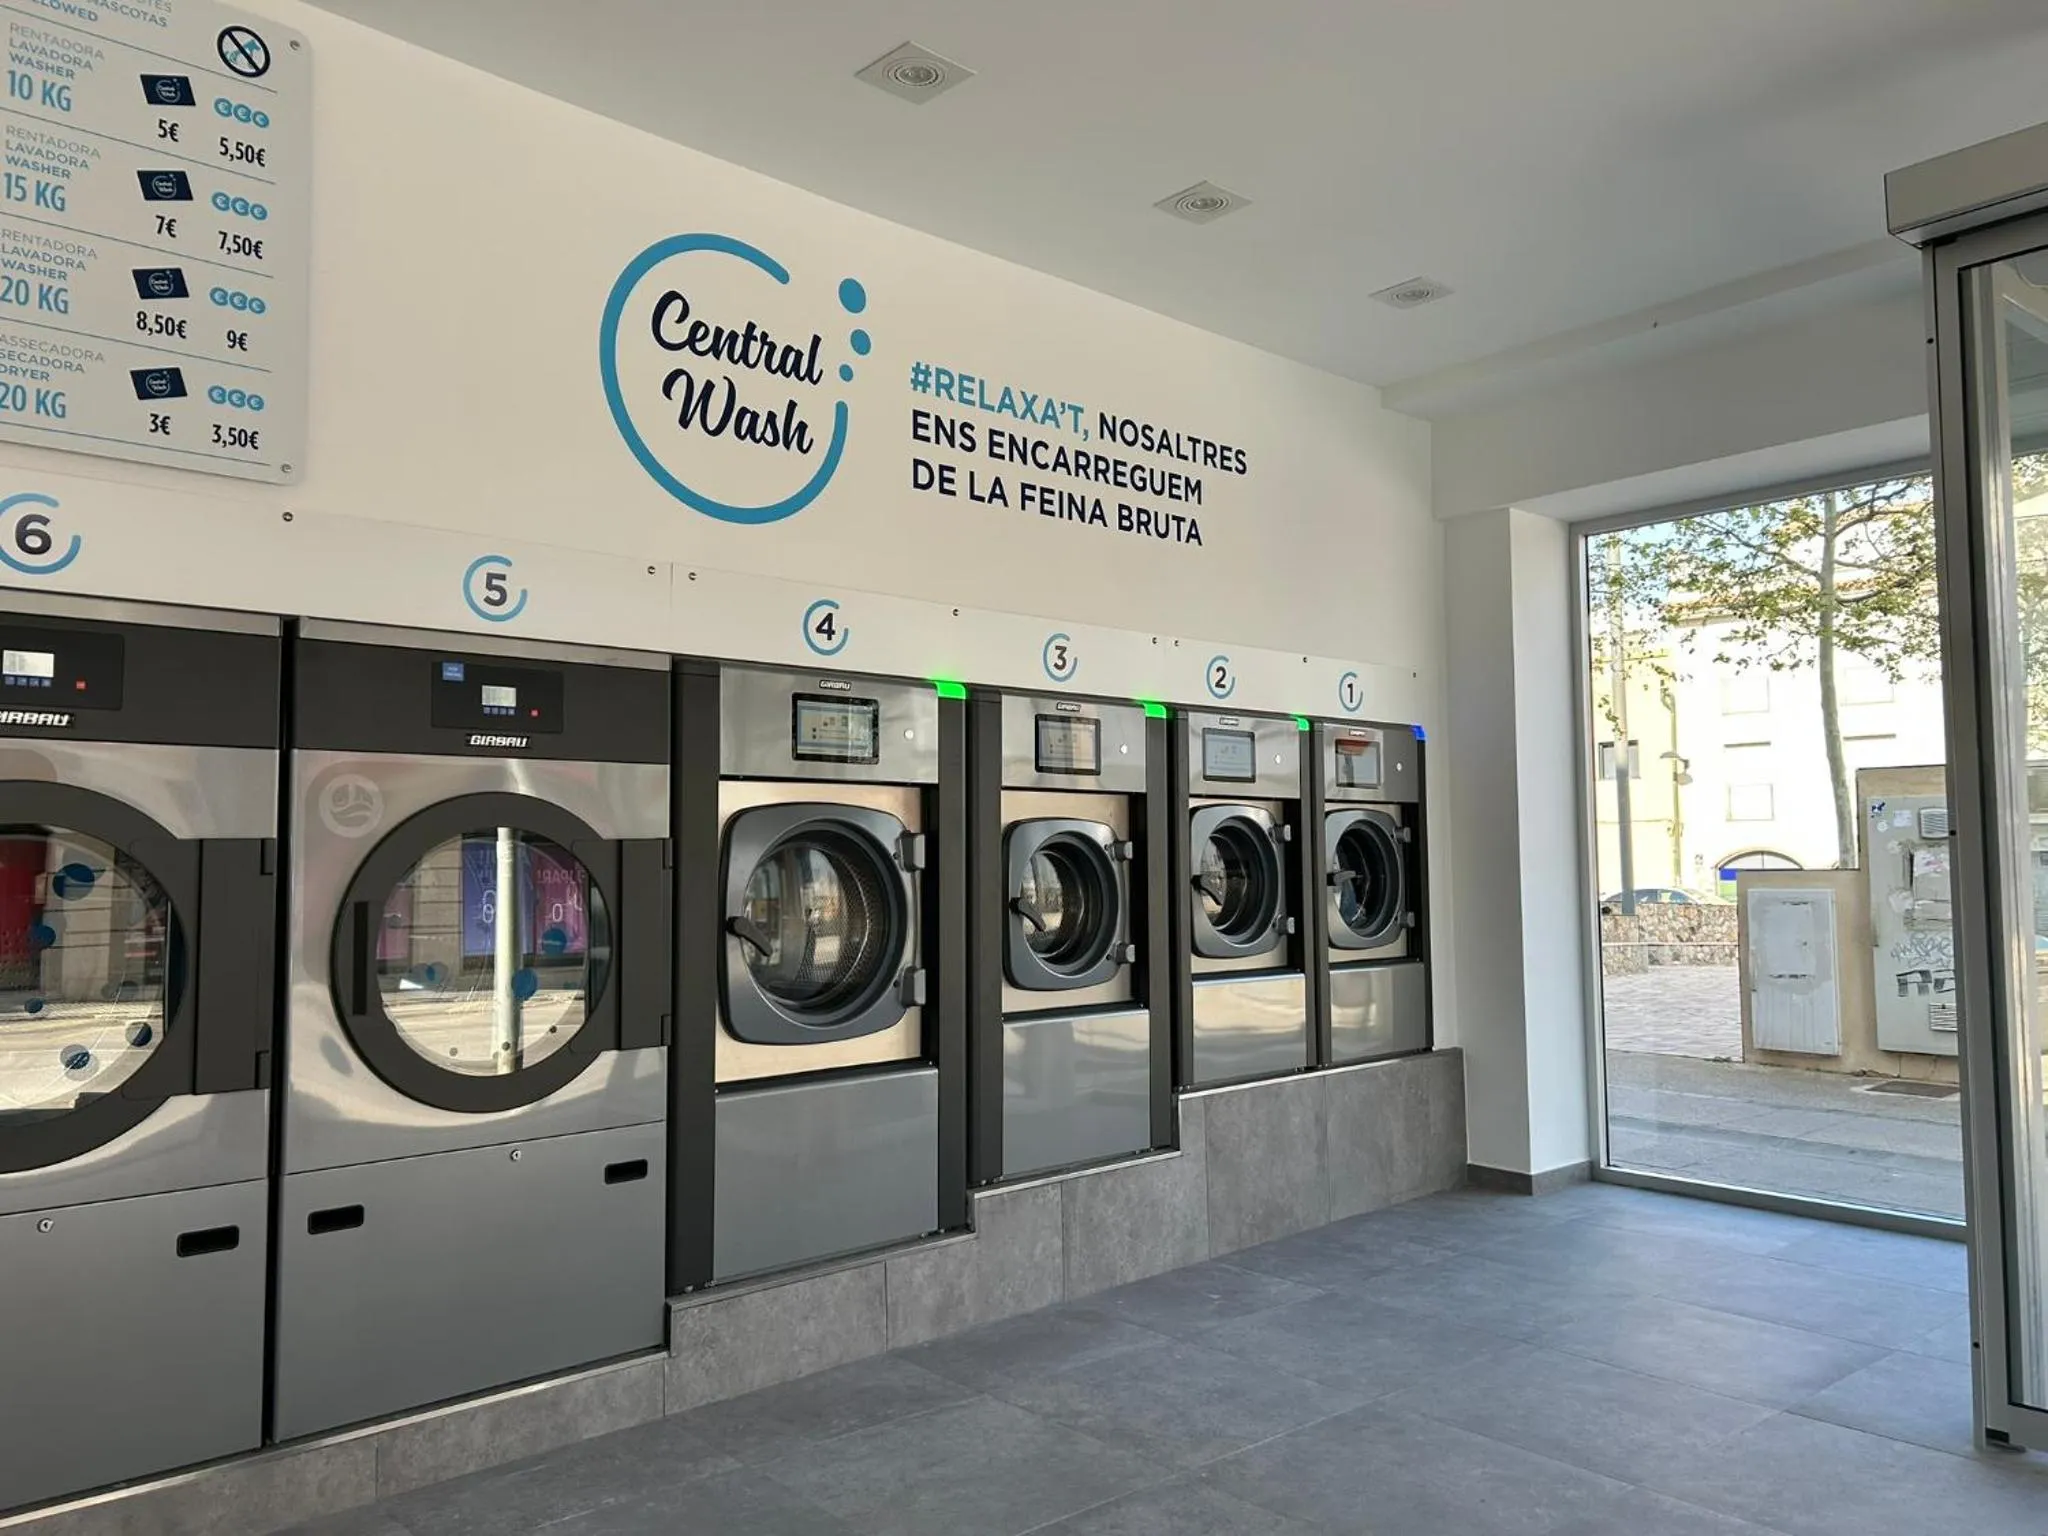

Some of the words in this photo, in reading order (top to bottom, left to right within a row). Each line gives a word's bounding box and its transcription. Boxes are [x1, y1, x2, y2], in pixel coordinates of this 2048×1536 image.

[9, 37, 93, 71] LAVADORA
[10, 22, 105, 60] RENTADORA
[9, 51, 75, 80] WASHER
[8, 70, 33, 100] 10
[42, 80, 71, 112] KG
[6, 124, 101, 159] RENTADORA
[158, 118, 179, 142] 5€
[5, 139, 89, 171] LAVADORA
[5, 154, 71, 180] WASHER
[219, 136, 266, 168] 5,50€
[4, 171, 27, 202] 15
[35, 180, 65, 212] KG
[155, 214, 177, 239] 7€
[0, 243, 86, 271] LAVADORA
[1, 228, 98, 260] RENTADORA
[218, 230, 263, 260] 7,50€
[1, 257, 68, 281] WASHER
[0, 276, 29, 306] 20
[38, 283, 69, 314] KG
[136, 311, 187, 339] 8,50€
[651, 290, 823, 386] Central
[0, 334, 105, 363] ASSECADORA
[227, 330, 248, 351] 9€
[0, 381, 26, 412] 20
[36, 388, 66, 419] KG
[662, 368, 814, 454] Wash
[149, 413, 171, 435] 3€
[212, 424, 259, 449] 3,50€
[912, 409, 977, 453] ENS
[987, 428, 1202, 505] ENCARREGUEM
[1099, 411, 1248, 476] NOSALTRES
[912, 458, 957, 497] DE
[968, 470, 1009, 509] LA
[1020, 482, 1108, 528] FEINA
[1117, 502, 1203, 547] BRUTA
[15, 513, 52, 555] 6
[483, 572, 508, 607] 5
[815, 612, 836, 641] 4
[1053, 645, 1067, 671] 3
[1214, 666, 1227, 689] 2
[1347, 682, 1354, 703] 1
[0, 710, 69, 726] IRBAU
[470, 734, 528, 748] GIRBAU
